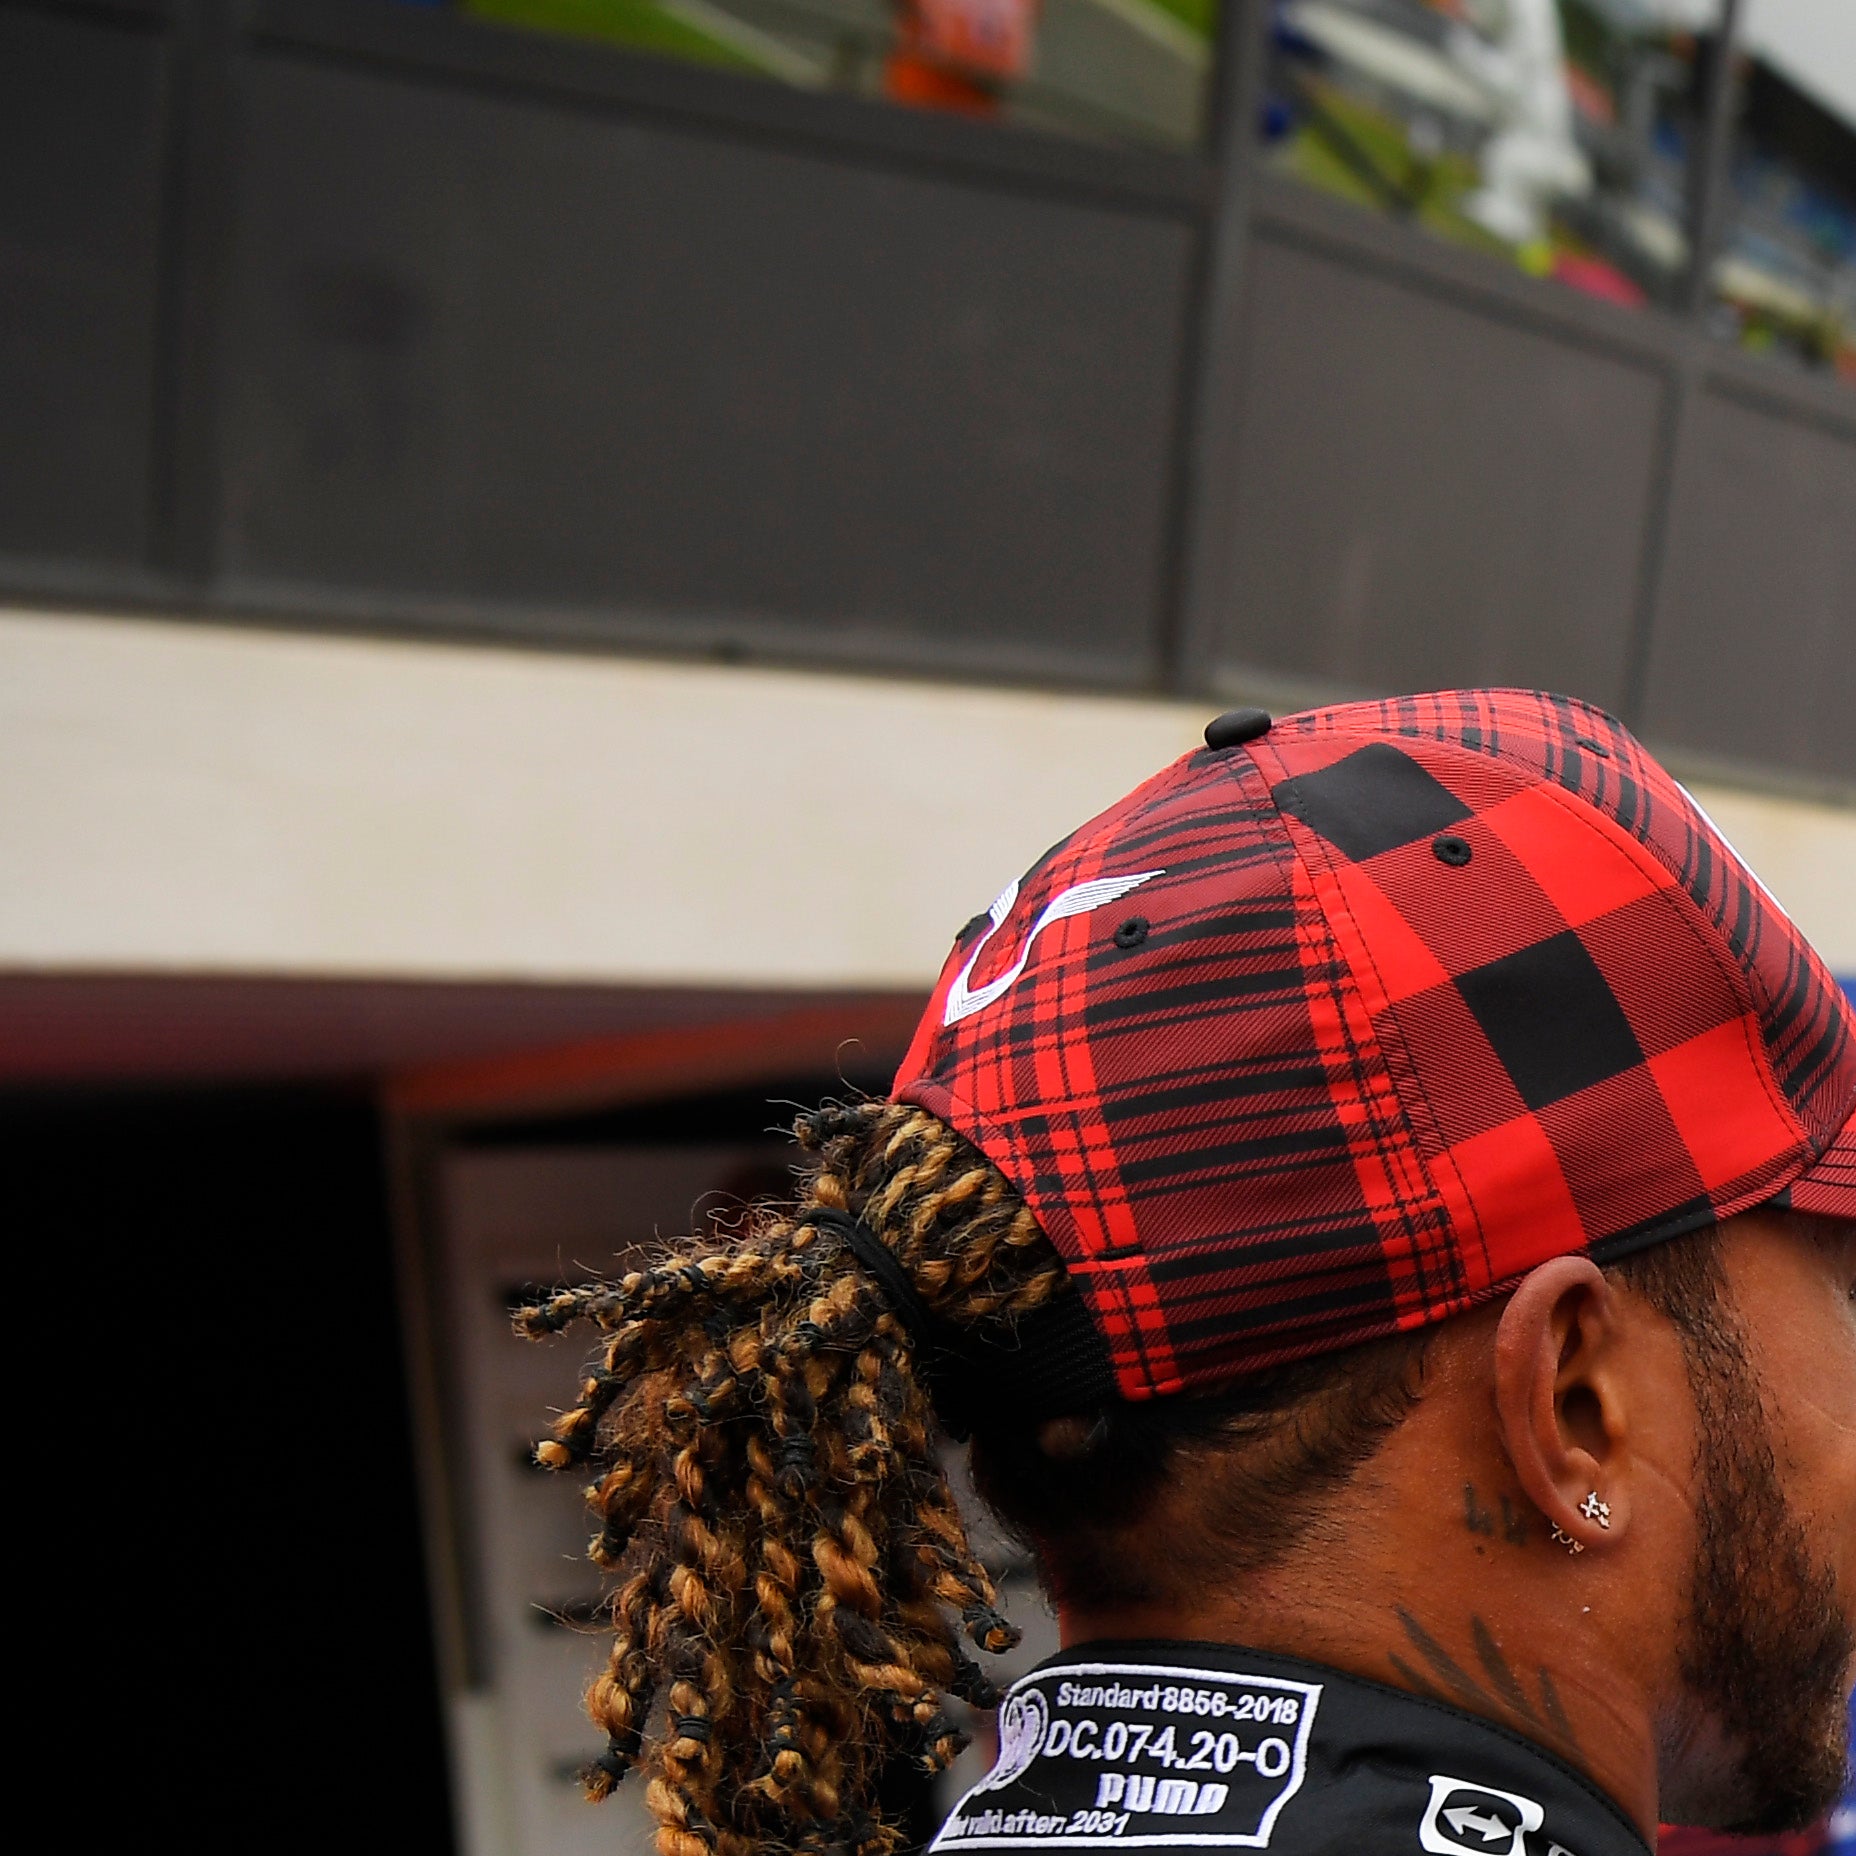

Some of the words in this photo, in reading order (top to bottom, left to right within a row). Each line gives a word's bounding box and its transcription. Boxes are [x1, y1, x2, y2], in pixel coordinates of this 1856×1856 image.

[1056, 1682, 1161, 1711] Standard
[1160, 1688, 1299, 1726] 8856-2018
[1064, 1810, 1130, 1836] 2031
